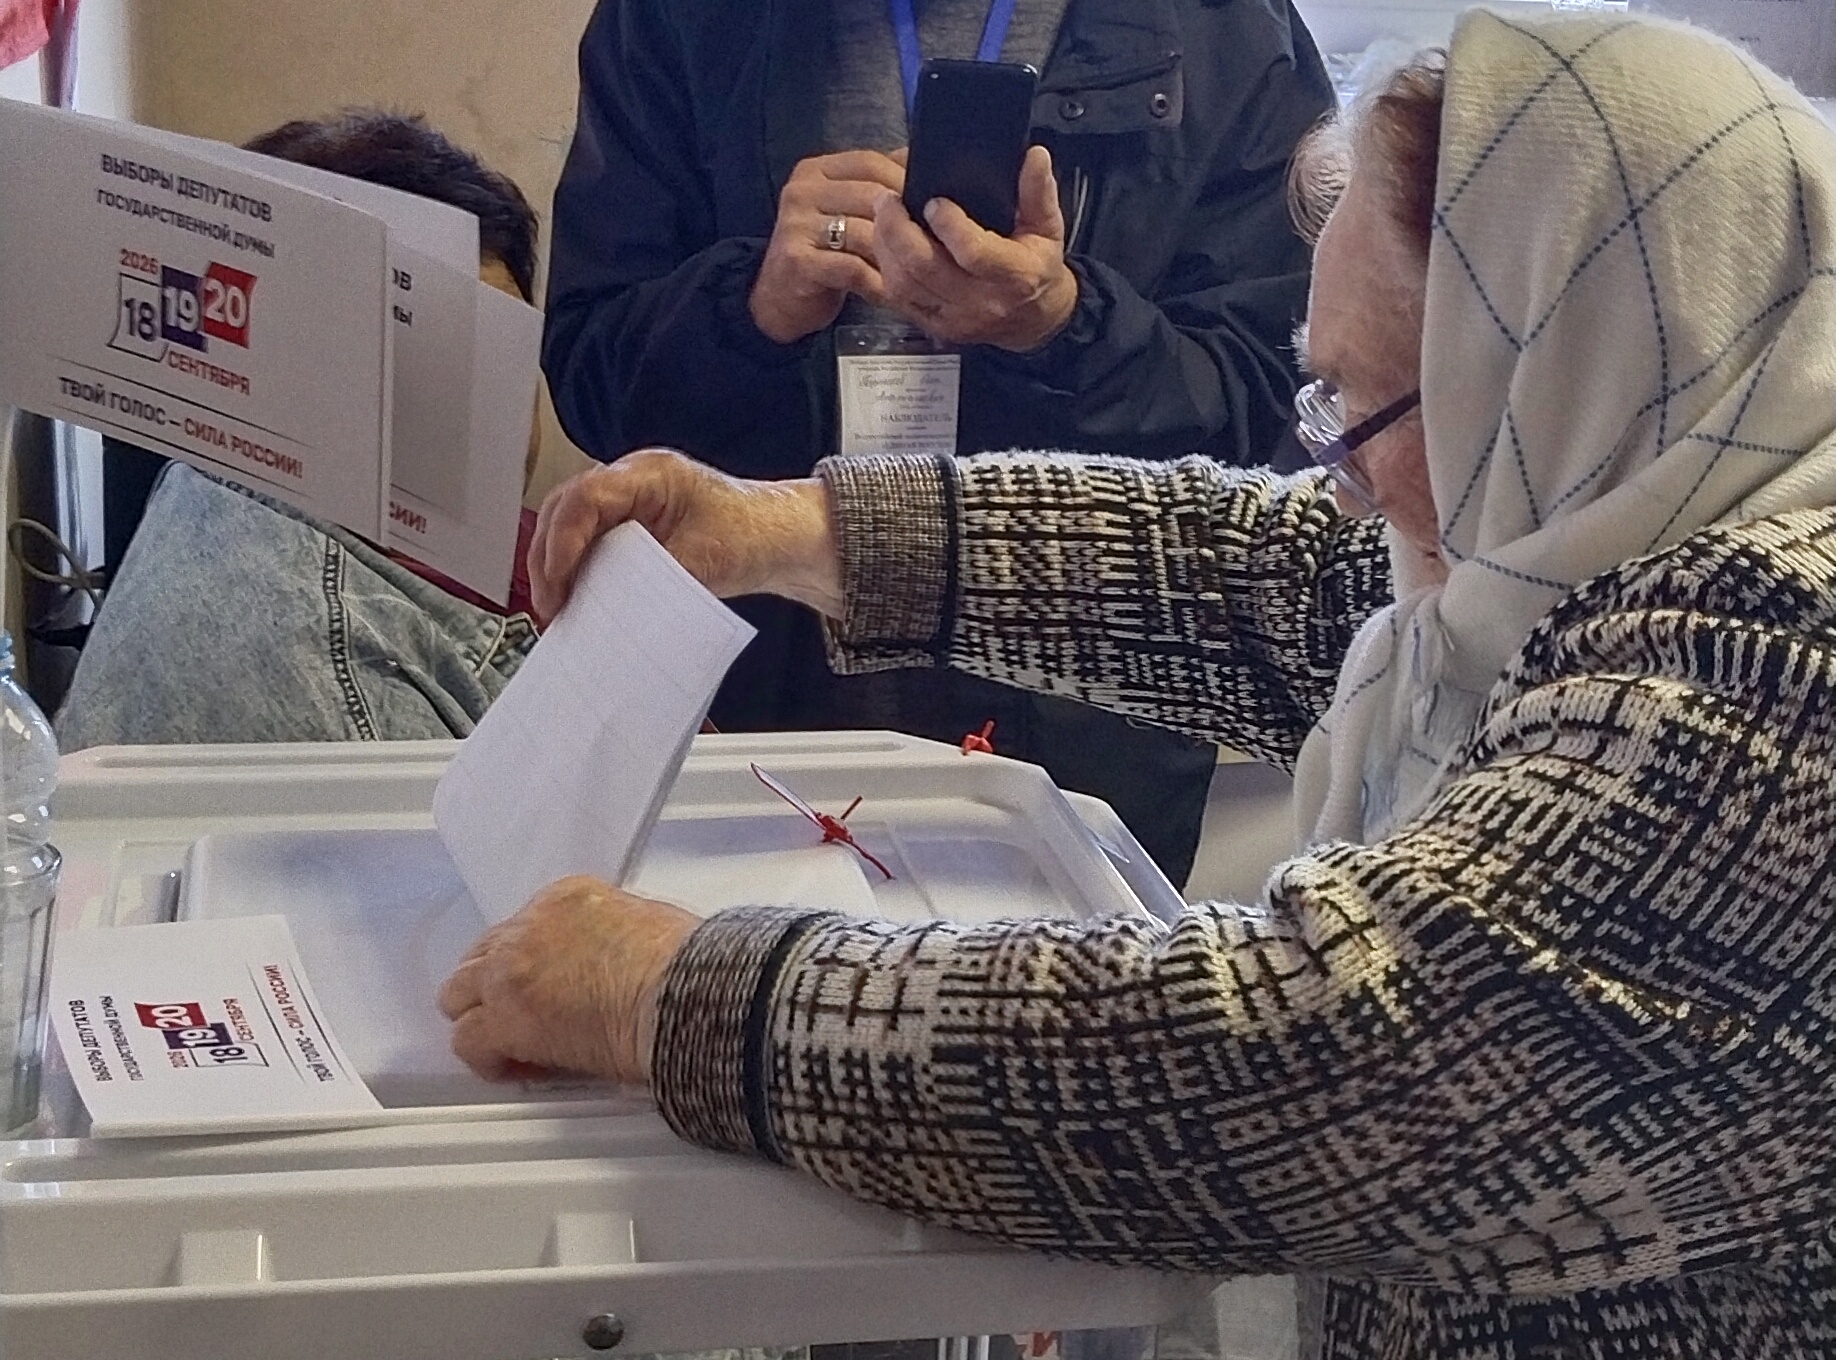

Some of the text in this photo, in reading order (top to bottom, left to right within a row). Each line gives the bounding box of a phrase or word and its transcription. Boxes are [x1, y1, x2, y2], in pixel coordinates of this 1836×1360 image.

[101, 153, 273, 223] ВЫБОРЫ ДЕПУТАТОВ
[96, 189, 275, 259] ГОСУДАРСТВЕННОЙ ДУМЫ
[120, 247, 159, 275] 2026
[124, 279, 248, 343] 18 19 20
[166, 349, 250, 397] СЕНТЯБРЯ
[58, 376, 107, 406] ТВОЙ
[111, 391, 167, 426] ГОЛОС
[183, 417, 228, 447] СИЛА
[230, 434, 303, 479] РОССИИ!
[263, 964, 294, 1005] РОССИИ!
[68, 999, 113, 1081] ВЫБОРЫ ДЕПУТАТОВ
[151, 1005, 248, 1064] 18 19 20
[222, 998, 255, 1041] СЕНТЯБРЯ
[281, 1005, 305, 1029] СИЛА
[295, 1036, 323, 1062] ГОЛОС
